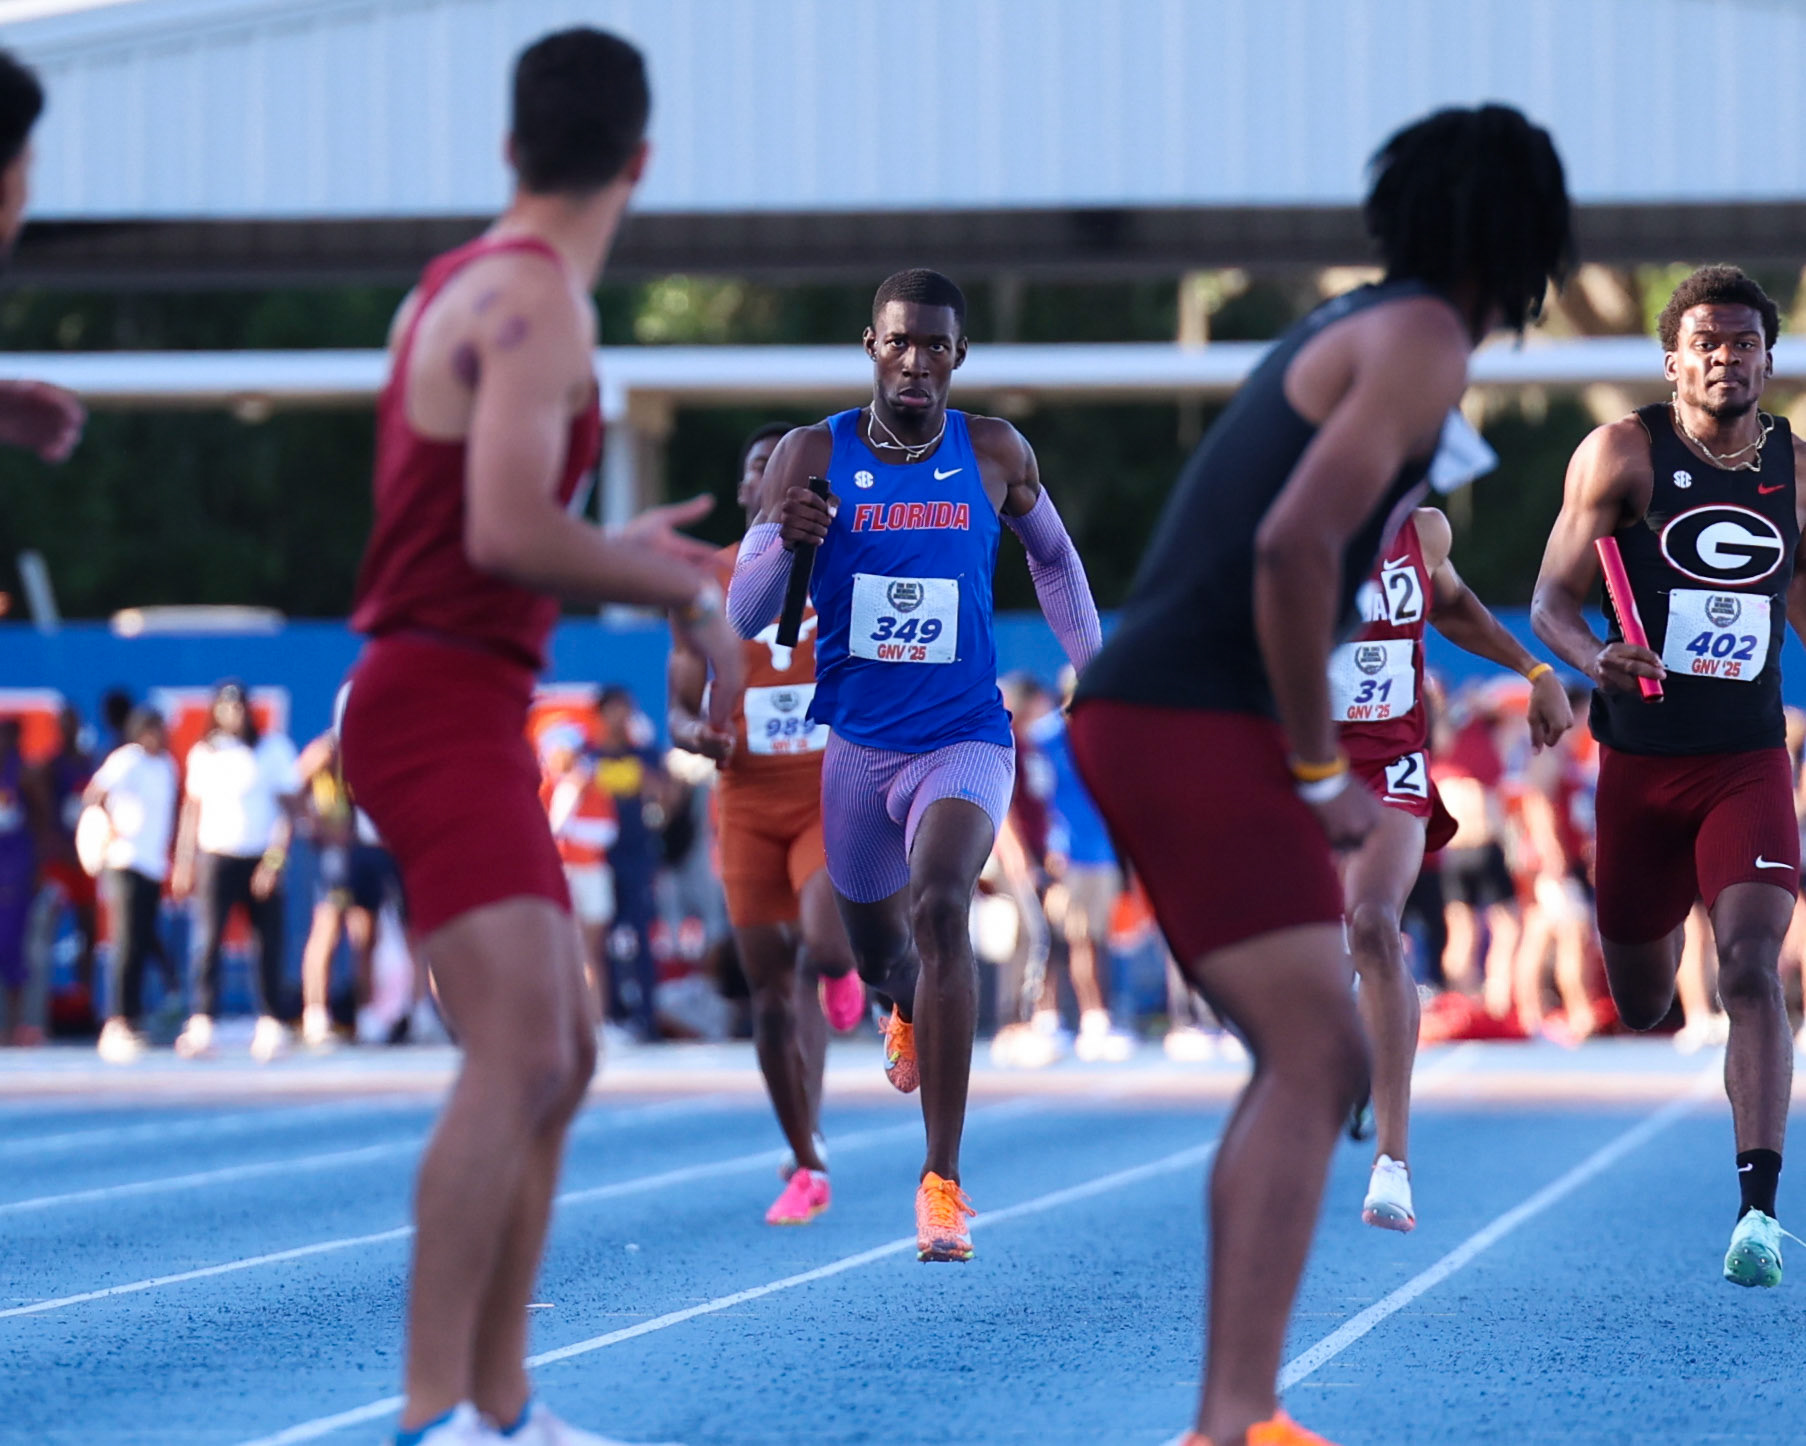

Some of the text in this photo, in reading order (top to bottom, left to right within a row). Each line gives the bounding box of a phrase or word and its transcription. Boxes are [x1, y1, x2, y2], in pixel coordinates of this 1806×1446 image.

[854, 470, 875, 489] SEC
[1673, 470, 1693, 489] SEC
[851, 502, 969, 532] FLORIDA
[1389, 572, 1417, 621] 2
[870, 616, 942, 644] 349
[877, 644, 927, 661] GNV '25
[1686, 631, 1758, 661] 402
[1692, 658, 1742, 677] GNV '25
[1354, 679, 1393, 704] 31
[1347, 704, 1391, 720] GNV '25
[1393, 756, 1420, 791] 2
